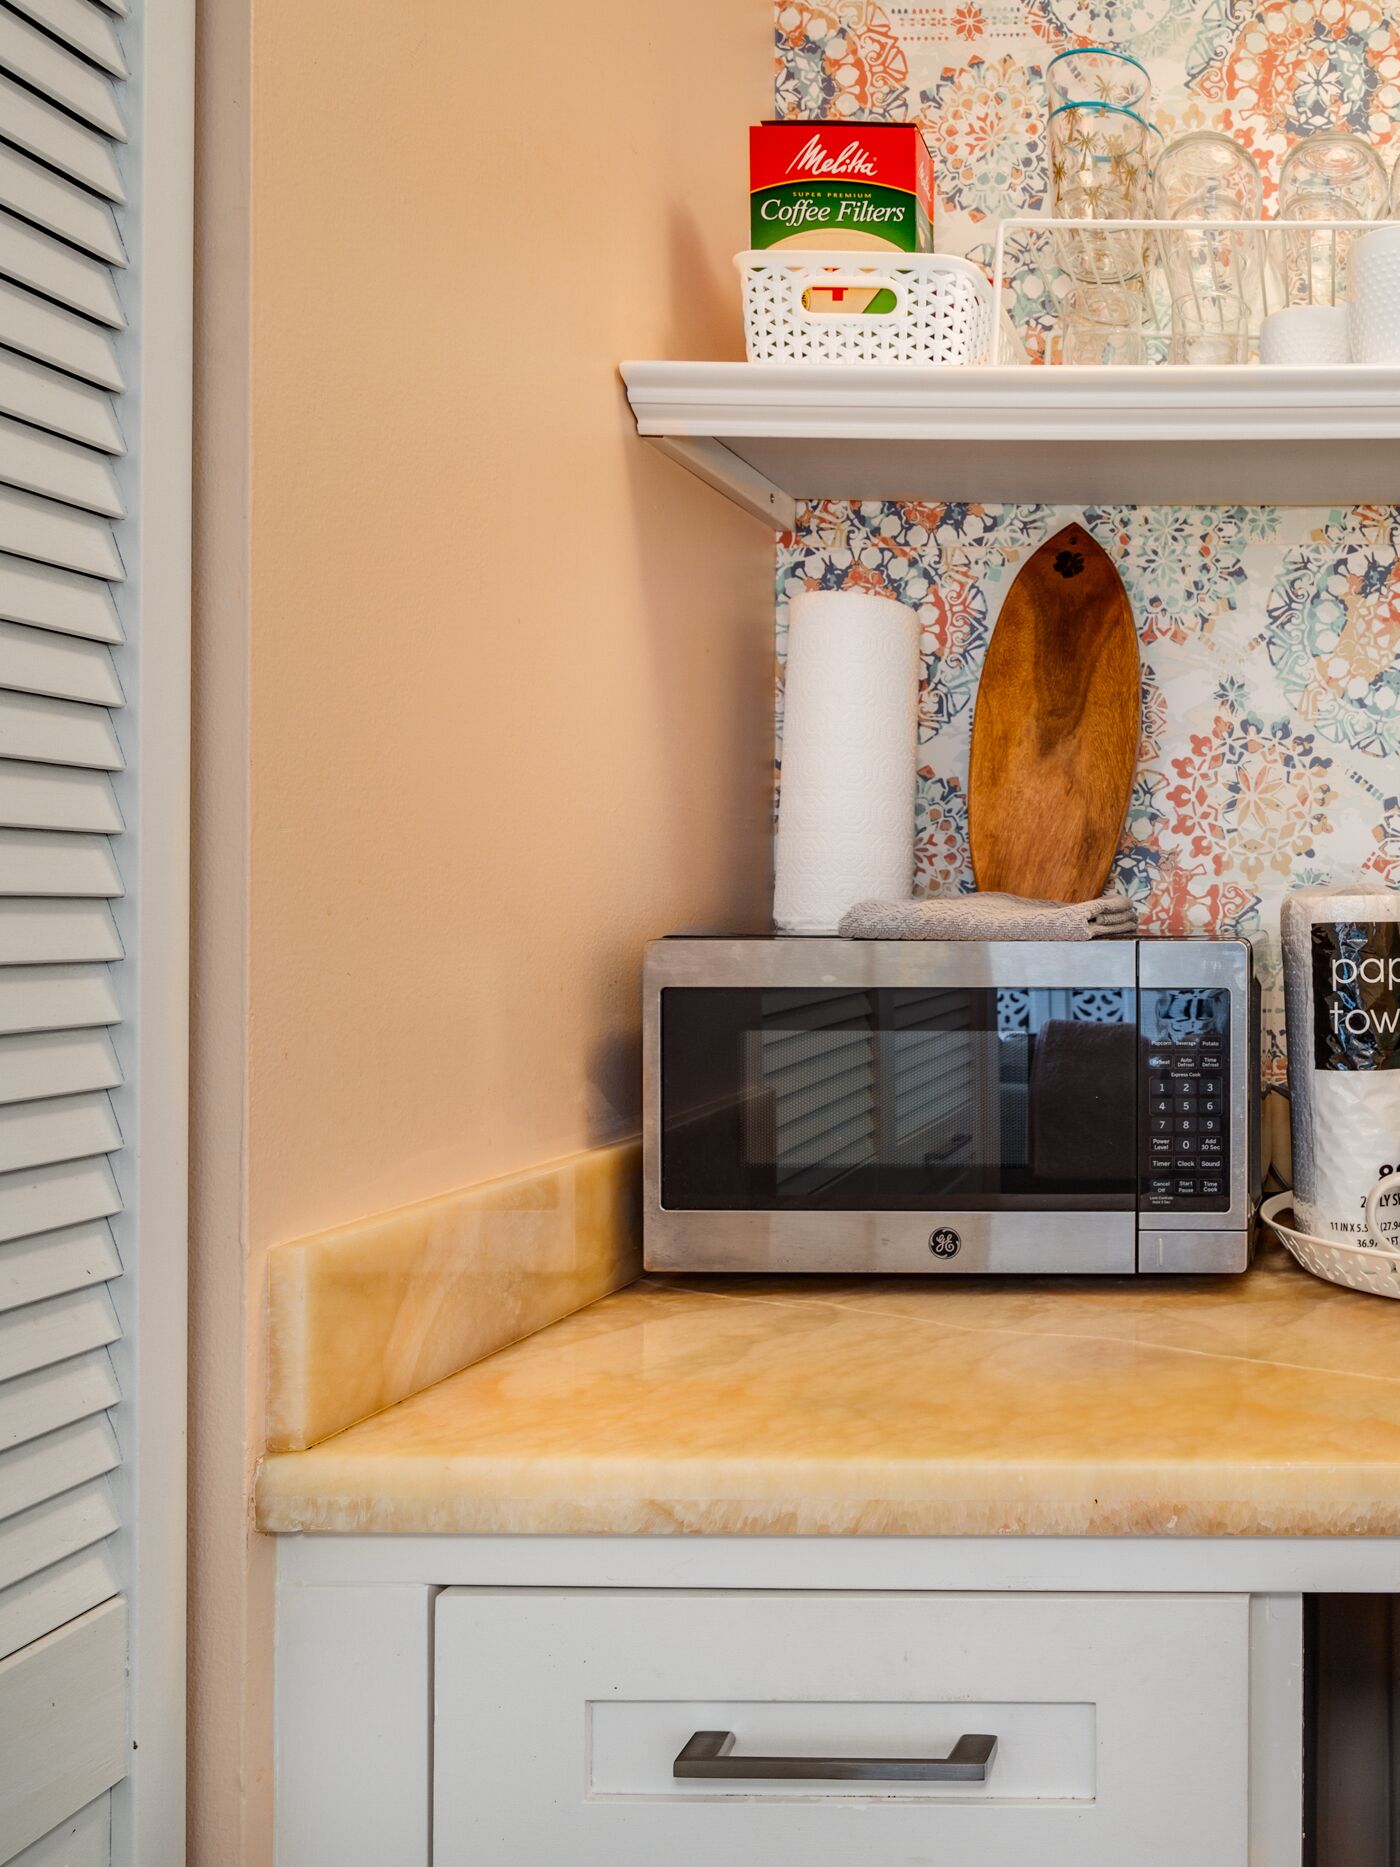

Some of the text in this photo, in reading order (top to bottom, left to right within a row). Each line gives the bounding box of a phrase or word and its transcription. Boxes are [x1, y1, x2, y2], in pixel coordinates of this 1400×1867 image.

[785, 133, 878, 176] Melitta
[827, 191, 872, 199] PREMIUM
[760, 198, 906, 227] Coffee Filters
[1159, 1083, 1165, 1092] 1
[1183, 1083, 1190, 1092] 2
[1207, 1083, 1214, 1092] 3
[1158, 1101, 1166, 1110] 4
[1183, 1101, 1190, 1110] 5
[1206, 1101, 1214, 1110] 6
[1159, 1120, 1166, 1129] 7
[1182, 1120, 1190, 1129] 8
[1206, 1120, 1214, 1129] 9
[1182, 1140, 1190, 1150] 0
[1330, 1222, 1339, 1232] 11
[1340, 1223, 1349, 1233] IN
[1349, 1223, 1355, 1233] X
